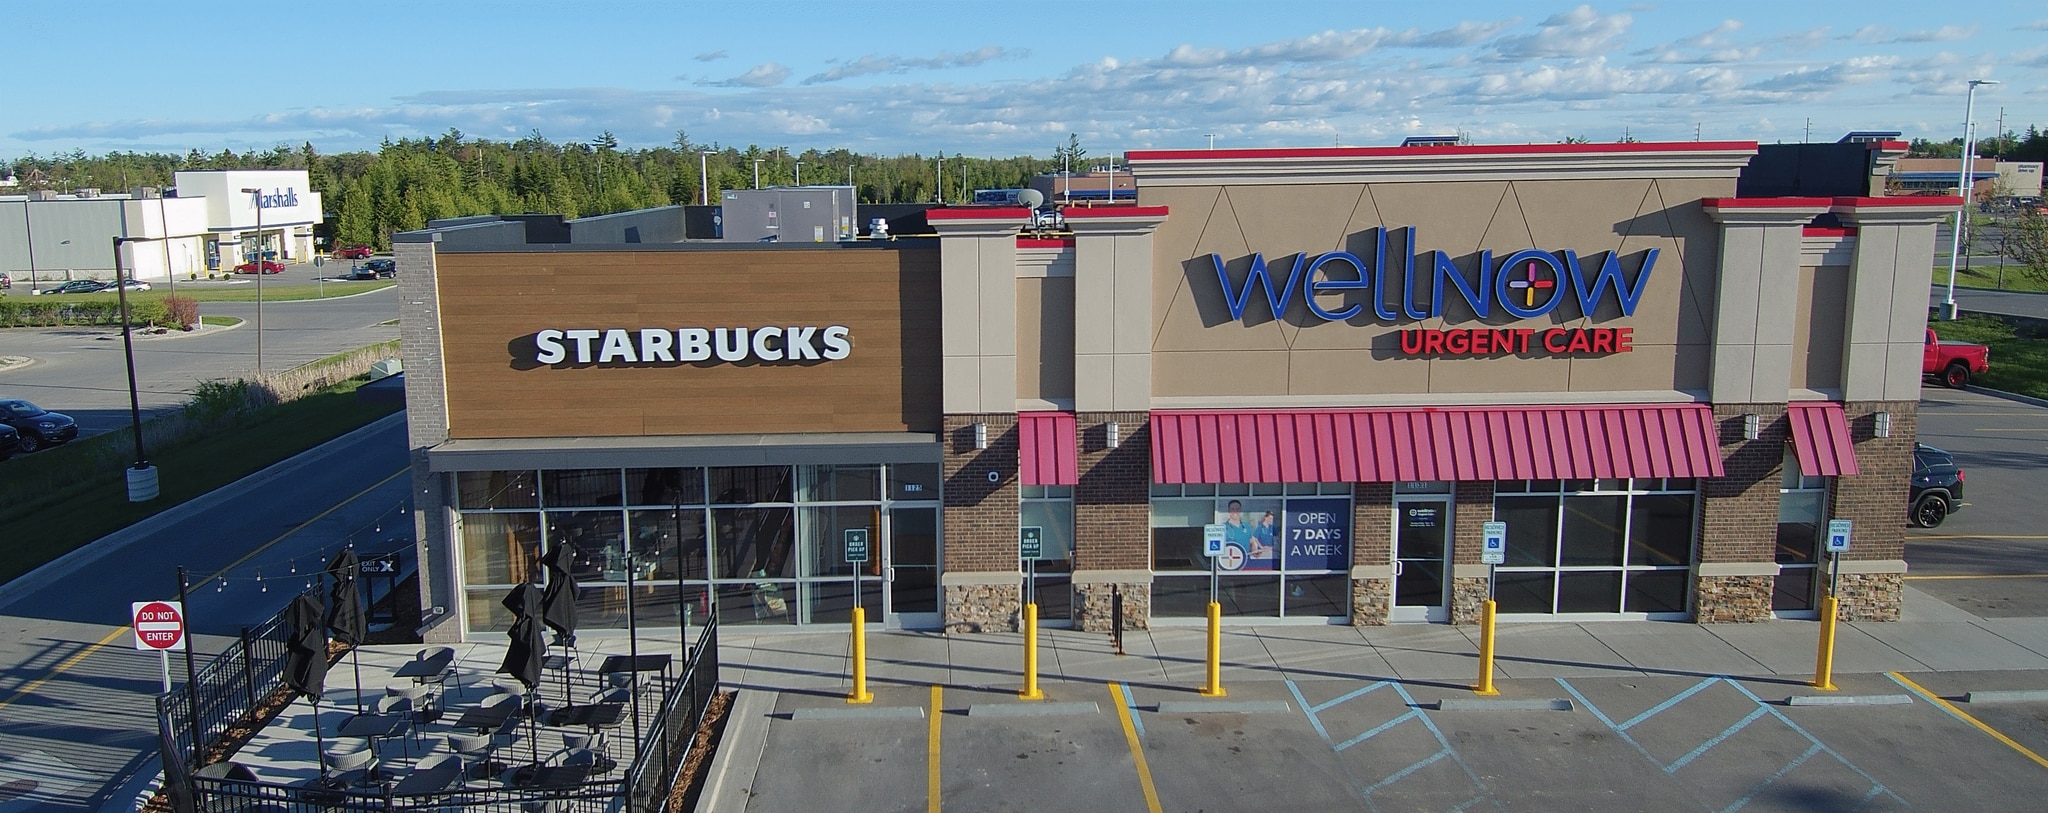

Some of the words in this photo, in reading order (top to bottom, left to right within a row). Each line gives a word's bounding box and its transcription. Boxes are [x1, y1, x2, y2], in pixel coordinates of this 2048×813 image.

[248, 187, 298, 209] Marshalls
[536, 325, 852, 364] STARBUCKS
[1400, 327, 1535, 354] URGENT
[1543, 327, 1633, 353] CARE
[1298, 512, 1336, 525] OPEN
[1292, 529, 1302, 540] 7
[1305, 528, 1341, 540] DAYS
[1290, 545, 1302, 556] A
[1304, 544, 1343, 556] WEEK
[142, 612, 154, 620] DO
[157, 611, 174, 620] NOT
[146, 632, 174, 641] ENTER
